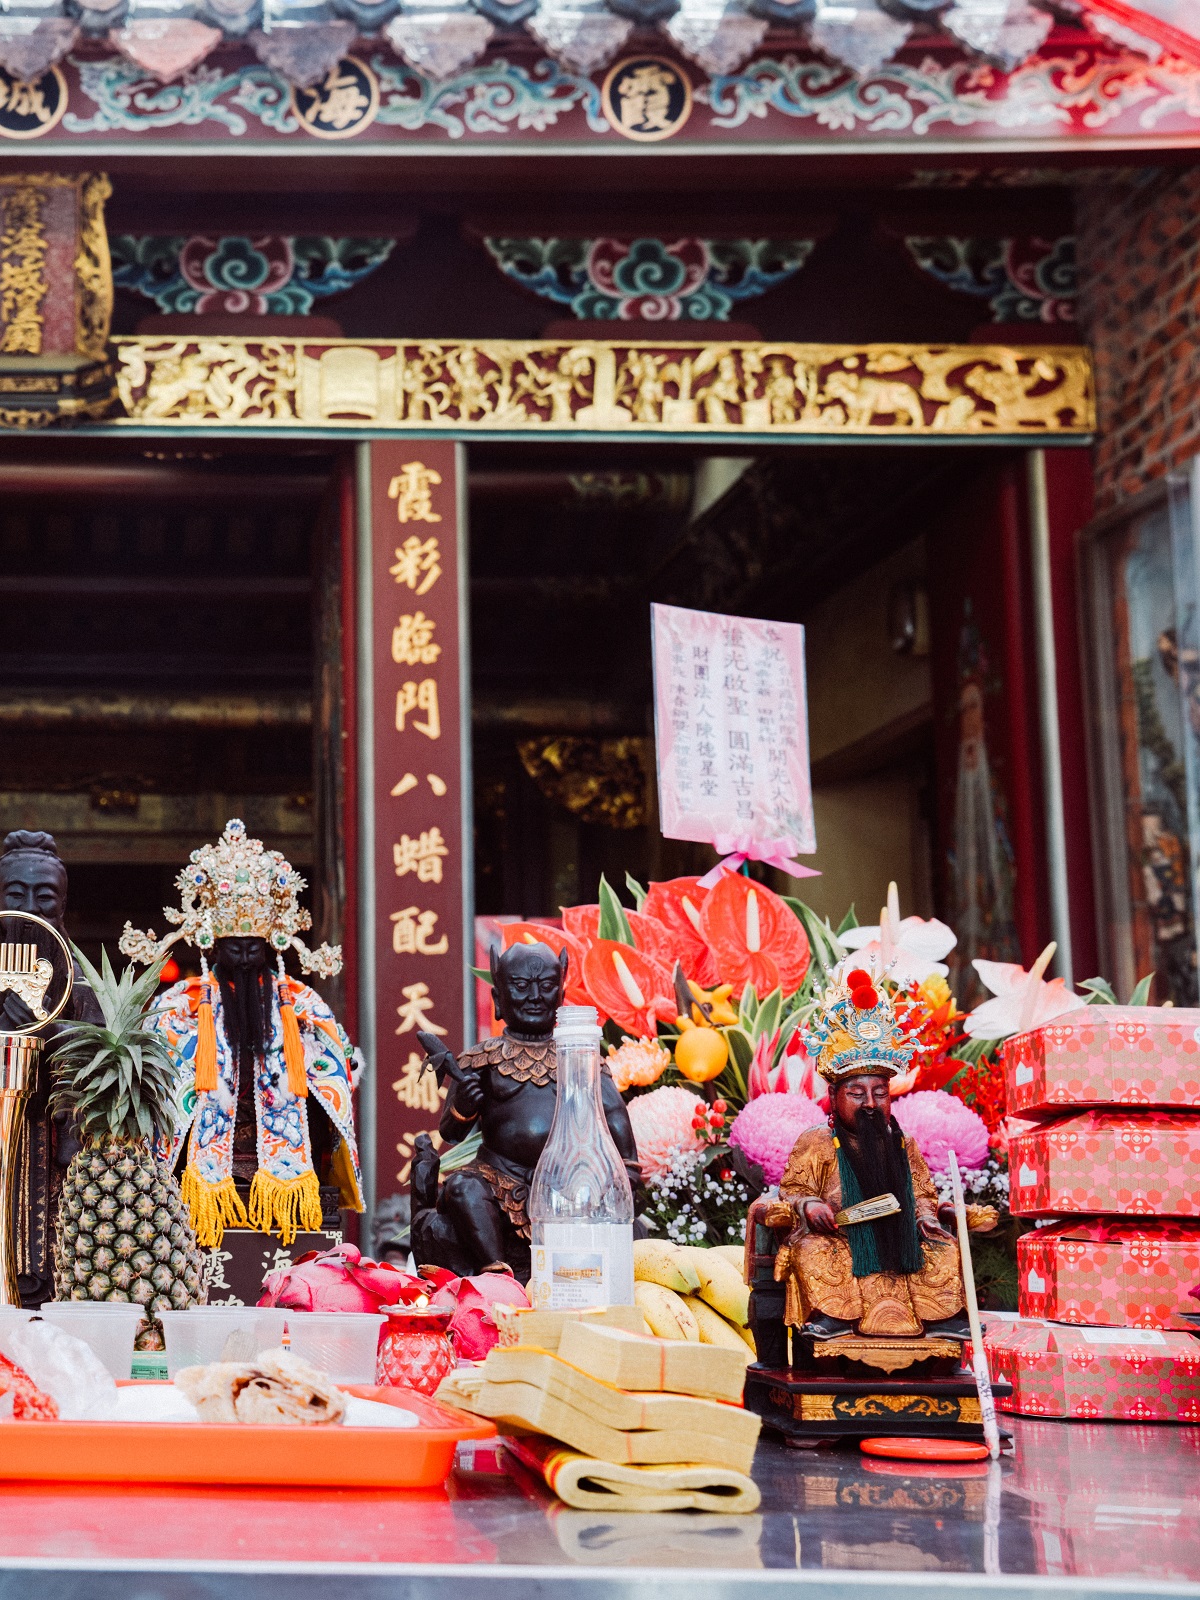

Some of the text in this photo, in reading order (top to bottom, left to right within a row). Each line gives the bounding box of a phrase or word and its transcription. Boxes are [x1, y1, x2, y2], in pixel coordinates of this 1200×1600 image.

[692, 646, 719, 797] 財團法人陳德星堂
[727, 730, 754, 820] 圓滿吉昌
